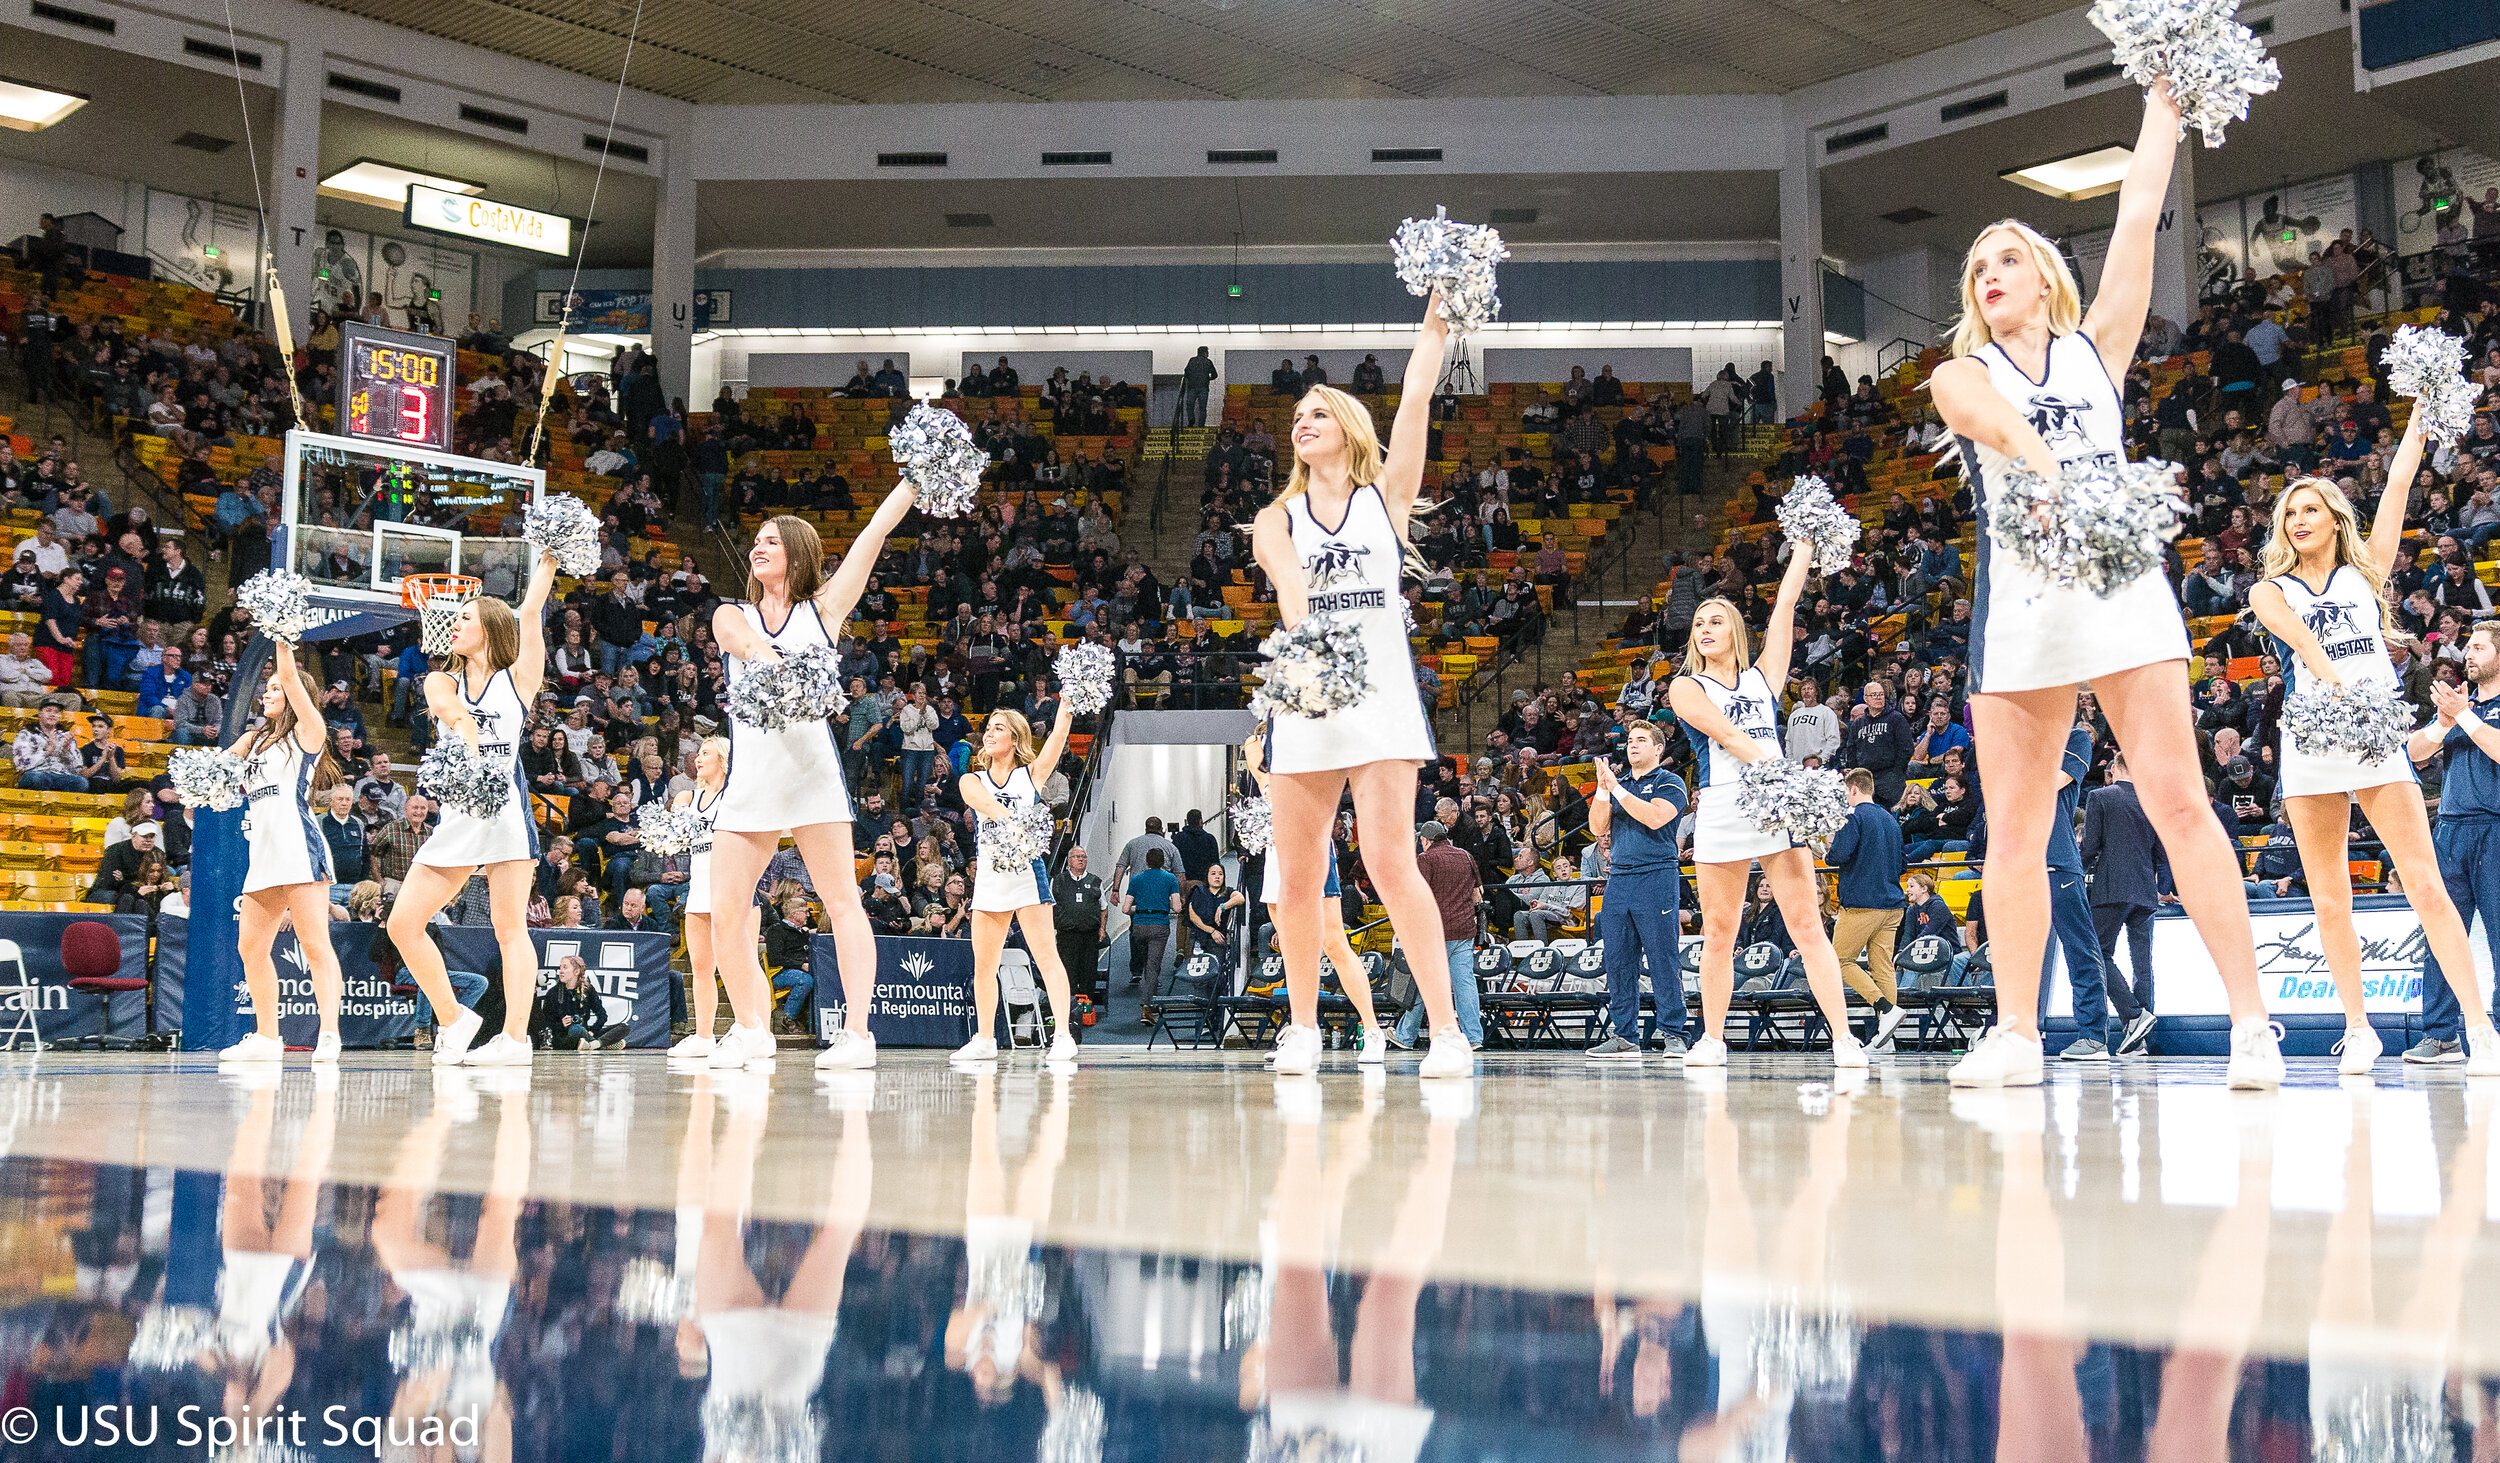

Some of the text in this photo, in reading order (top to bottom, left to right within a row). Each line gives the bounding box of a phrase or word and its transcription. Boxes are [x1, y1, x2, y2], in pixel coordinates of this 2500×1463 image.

[510, 209, 542, 239] Vida
[290, 226, 306, 247] T
[672, 302, 686, 322] U
[1788, 295, 1801, 315] V
[370, 349, 438, 387] 15:00
[400, 387, 428, 442] 3
[1340, 589, 1385, 610] STATE
[2337, 637, 2375, 658] STATE
[1792, 714, 1819, 727] USU
[340, 1000, 415, 1019] Hospital
[881, 1001, 940, 1019] Regional
